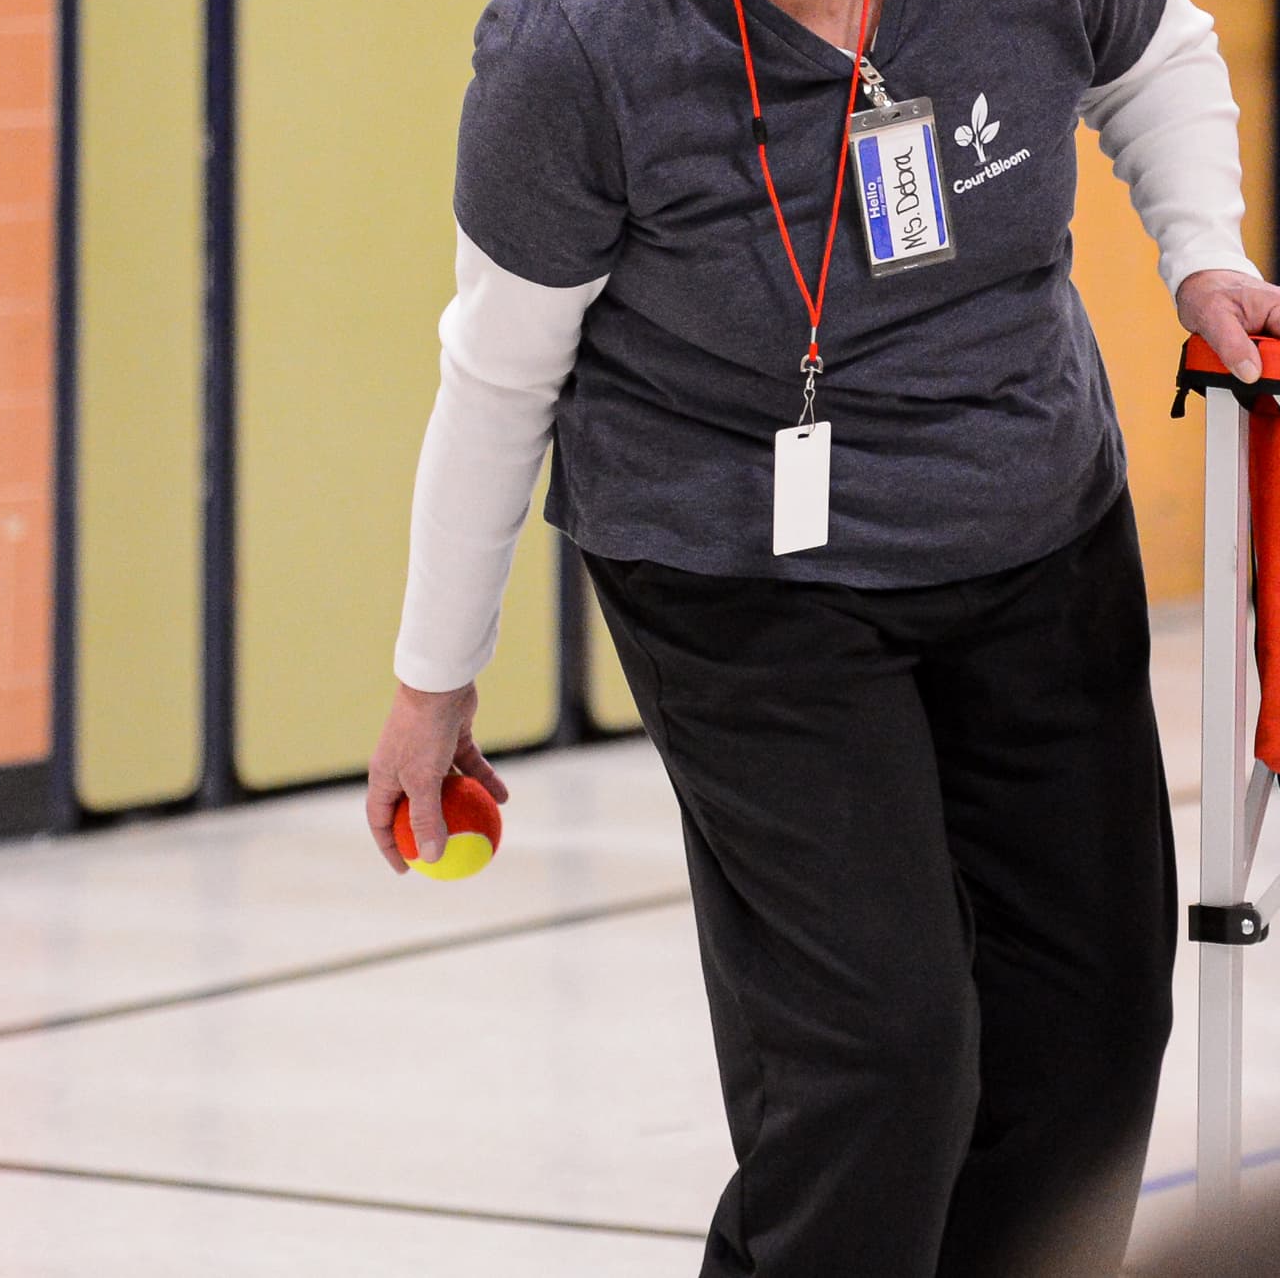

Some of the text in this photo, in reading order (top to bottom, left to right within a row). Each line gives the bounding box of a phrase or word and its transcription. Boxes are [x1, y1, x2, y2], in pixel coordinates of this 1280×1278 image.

[952, 148, 1031, 195] CourtBloom
[866, 181, 881, 219] Hello
[893, 146, 928, 250] Ms. Debra
